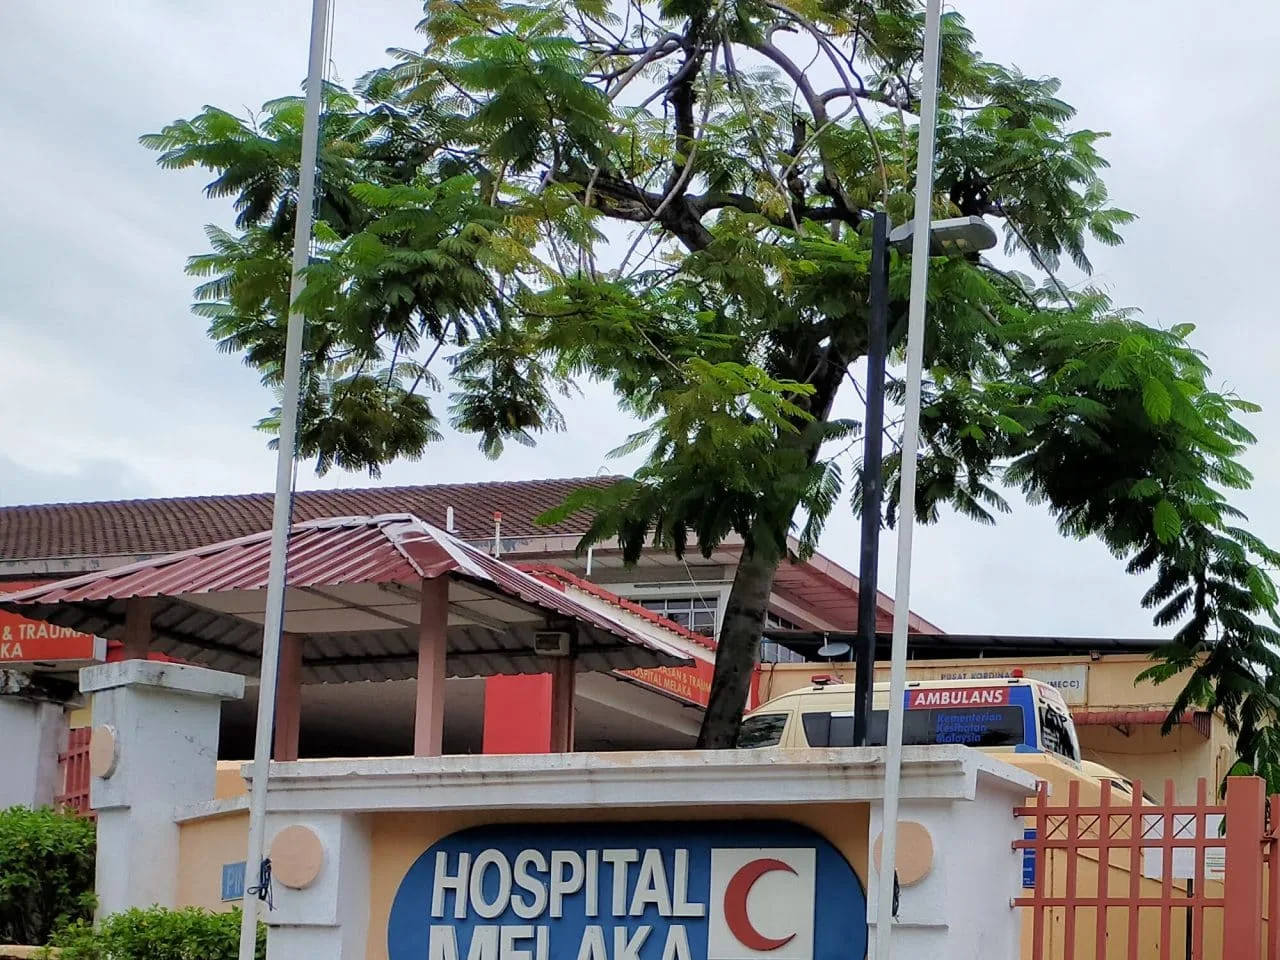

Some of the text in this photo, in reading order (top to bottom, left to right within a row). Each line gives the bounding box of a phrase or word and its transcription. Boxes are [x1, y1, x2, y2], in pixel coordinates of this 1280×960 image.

[2, 623, 91, 640] & TRAUM
[664, 679, 692, 698] MELAKA
[915, 690, 1003, 706] AMBULANS
[430, 848, 706, 919] HOSPITAL
